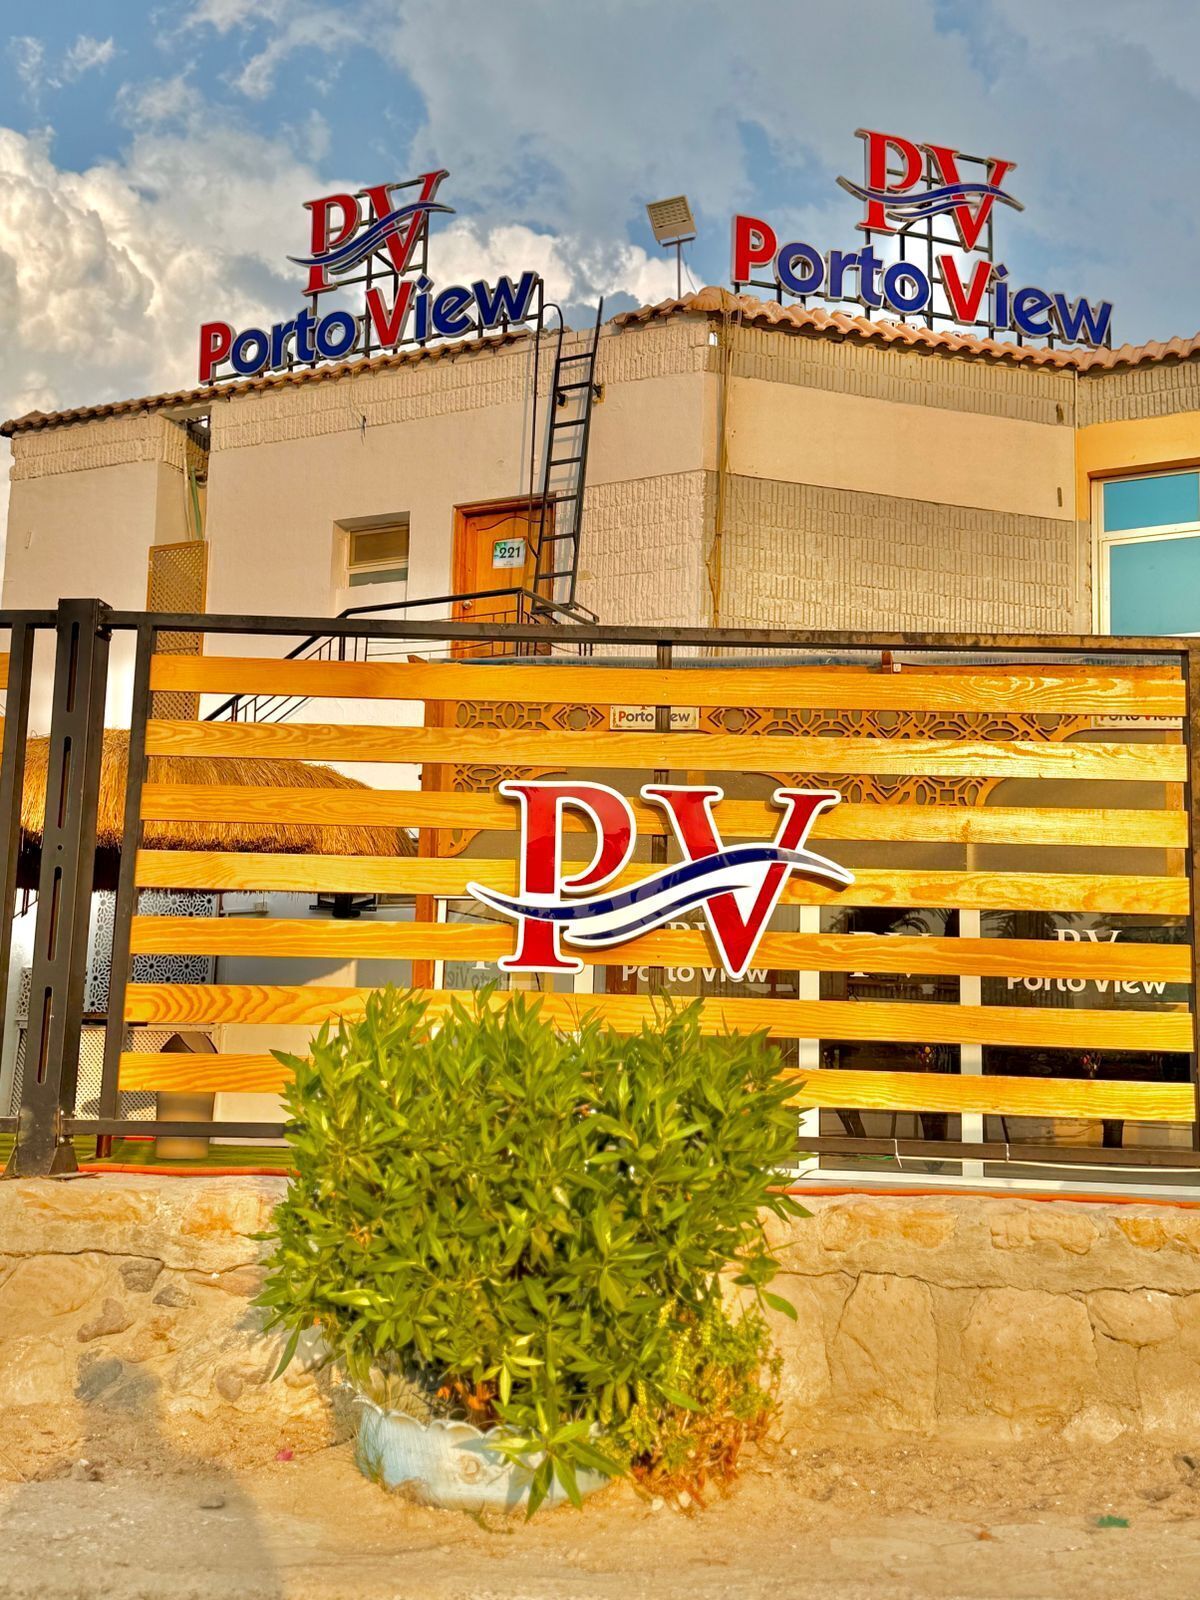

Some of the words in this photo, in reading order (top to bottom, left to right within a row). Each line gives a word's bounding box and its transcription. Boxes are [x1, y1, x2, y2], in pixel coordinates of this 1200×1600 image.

[854, 128, 1017, 252] PV
[302, 169, 449, 296] PV
[499, 546, 521, 559] 221
[618, 711, 655, 722] Porto
[498, 780, 841, 978] PV
[622, 966, 695, 982] Poto
[702, 967, 769, 983] Viw
